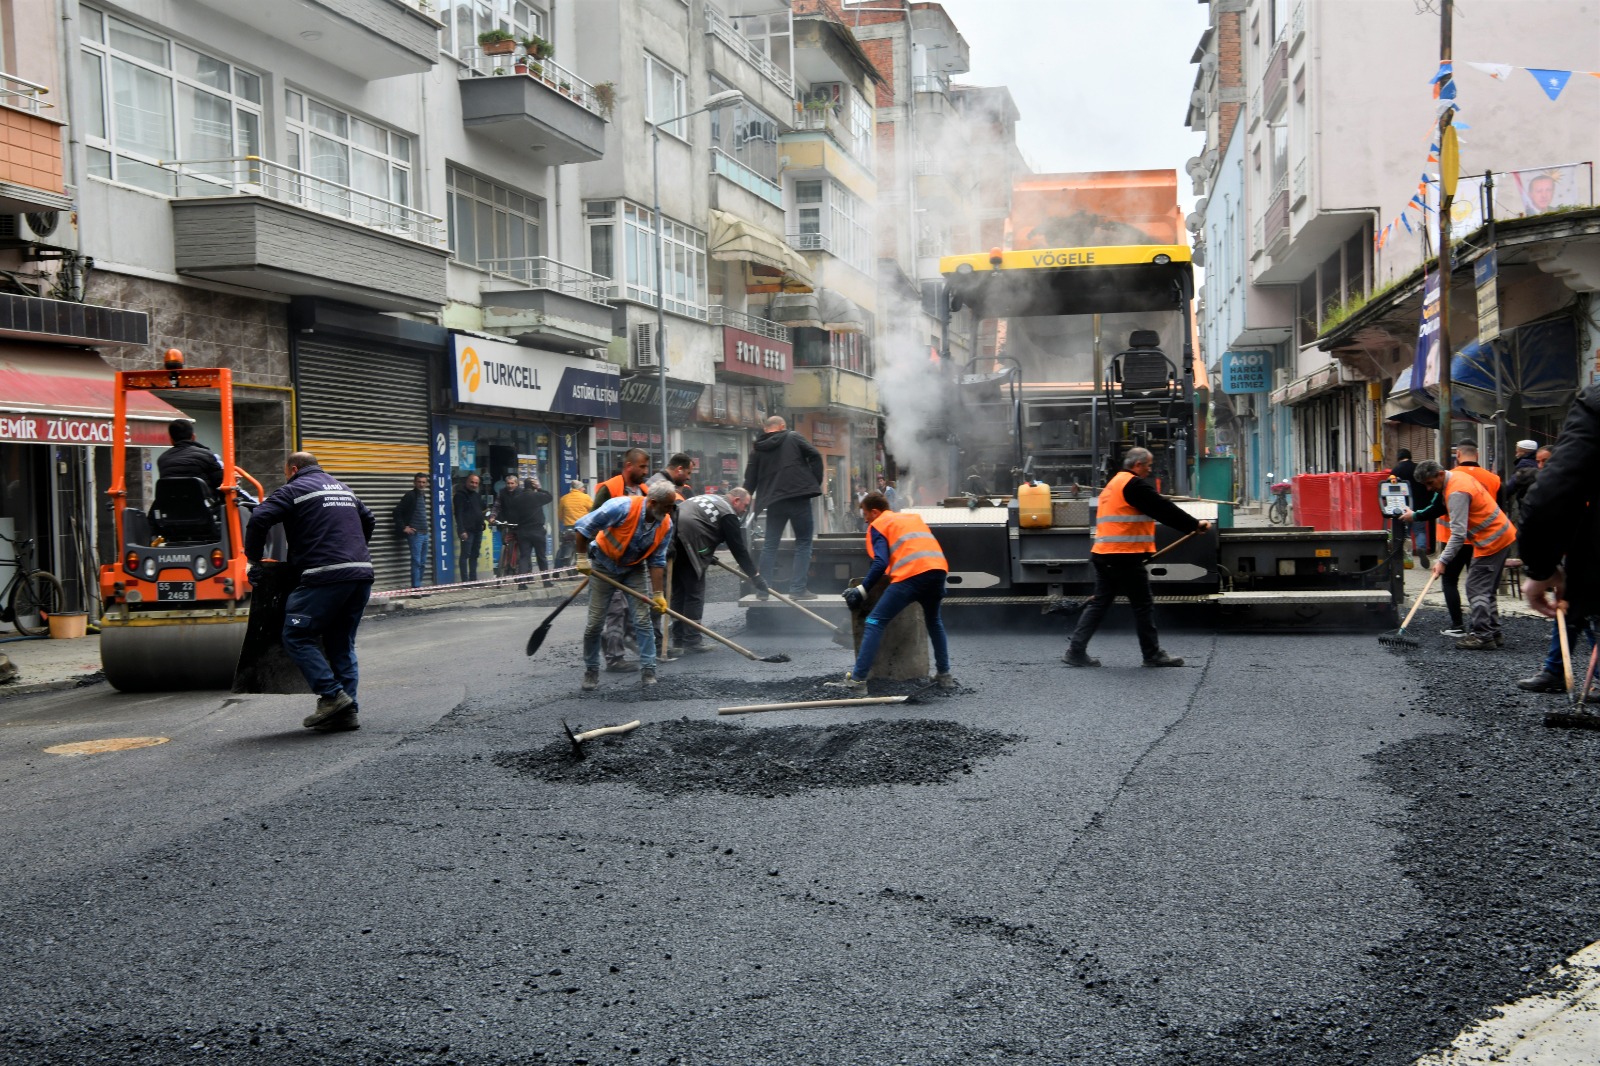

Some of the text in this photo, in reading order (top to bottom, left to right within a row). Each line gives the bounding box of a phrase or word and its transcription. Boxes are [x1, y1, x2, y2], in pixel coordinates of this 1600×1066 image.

[1032, 251, 1095, 266] VÖGELE
[736, 341, 760, 365] FOTO
[1230, 355, 1264, 366] A-101
[483, 360, 541, 390] TURKCELL
[1230, 366, 1264, 374] HARCA
[1230, 374, 1264, 382] HARCA
[572, 383, 618, 405] ASTÜRK İLETİŞİM
[620, 381, 652, 404] ASYA
[47, 418, 131, 443] ZÜCCACİE
[438, 462, 448, 571] TURKCELL
[158, 555, 191, 563] HAMM
[158, 583, 194, 591] 55 22
